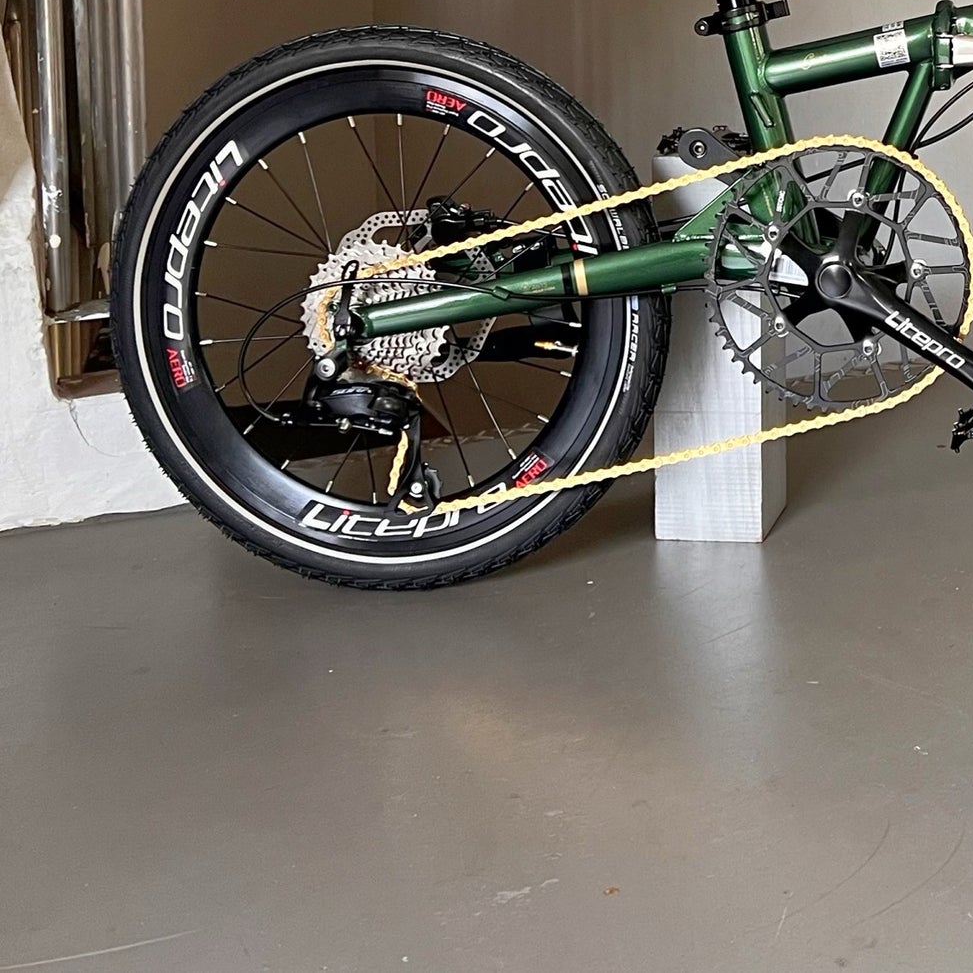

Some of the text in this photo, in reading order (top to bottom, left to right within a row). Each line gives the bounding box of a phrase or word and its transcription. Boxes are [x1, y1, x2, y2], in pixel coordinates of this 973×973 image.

[426, 90, 467, 111] AERO
[466, 110, 599, 256] itepro
[162, 139, 244, 342] Litepro
[628, 312, 640, 362] RACER
[884, 310, 967, 370] Litepro
[166, 348, 187, 388] AERO
[514, 459, 548, 488] AERO
